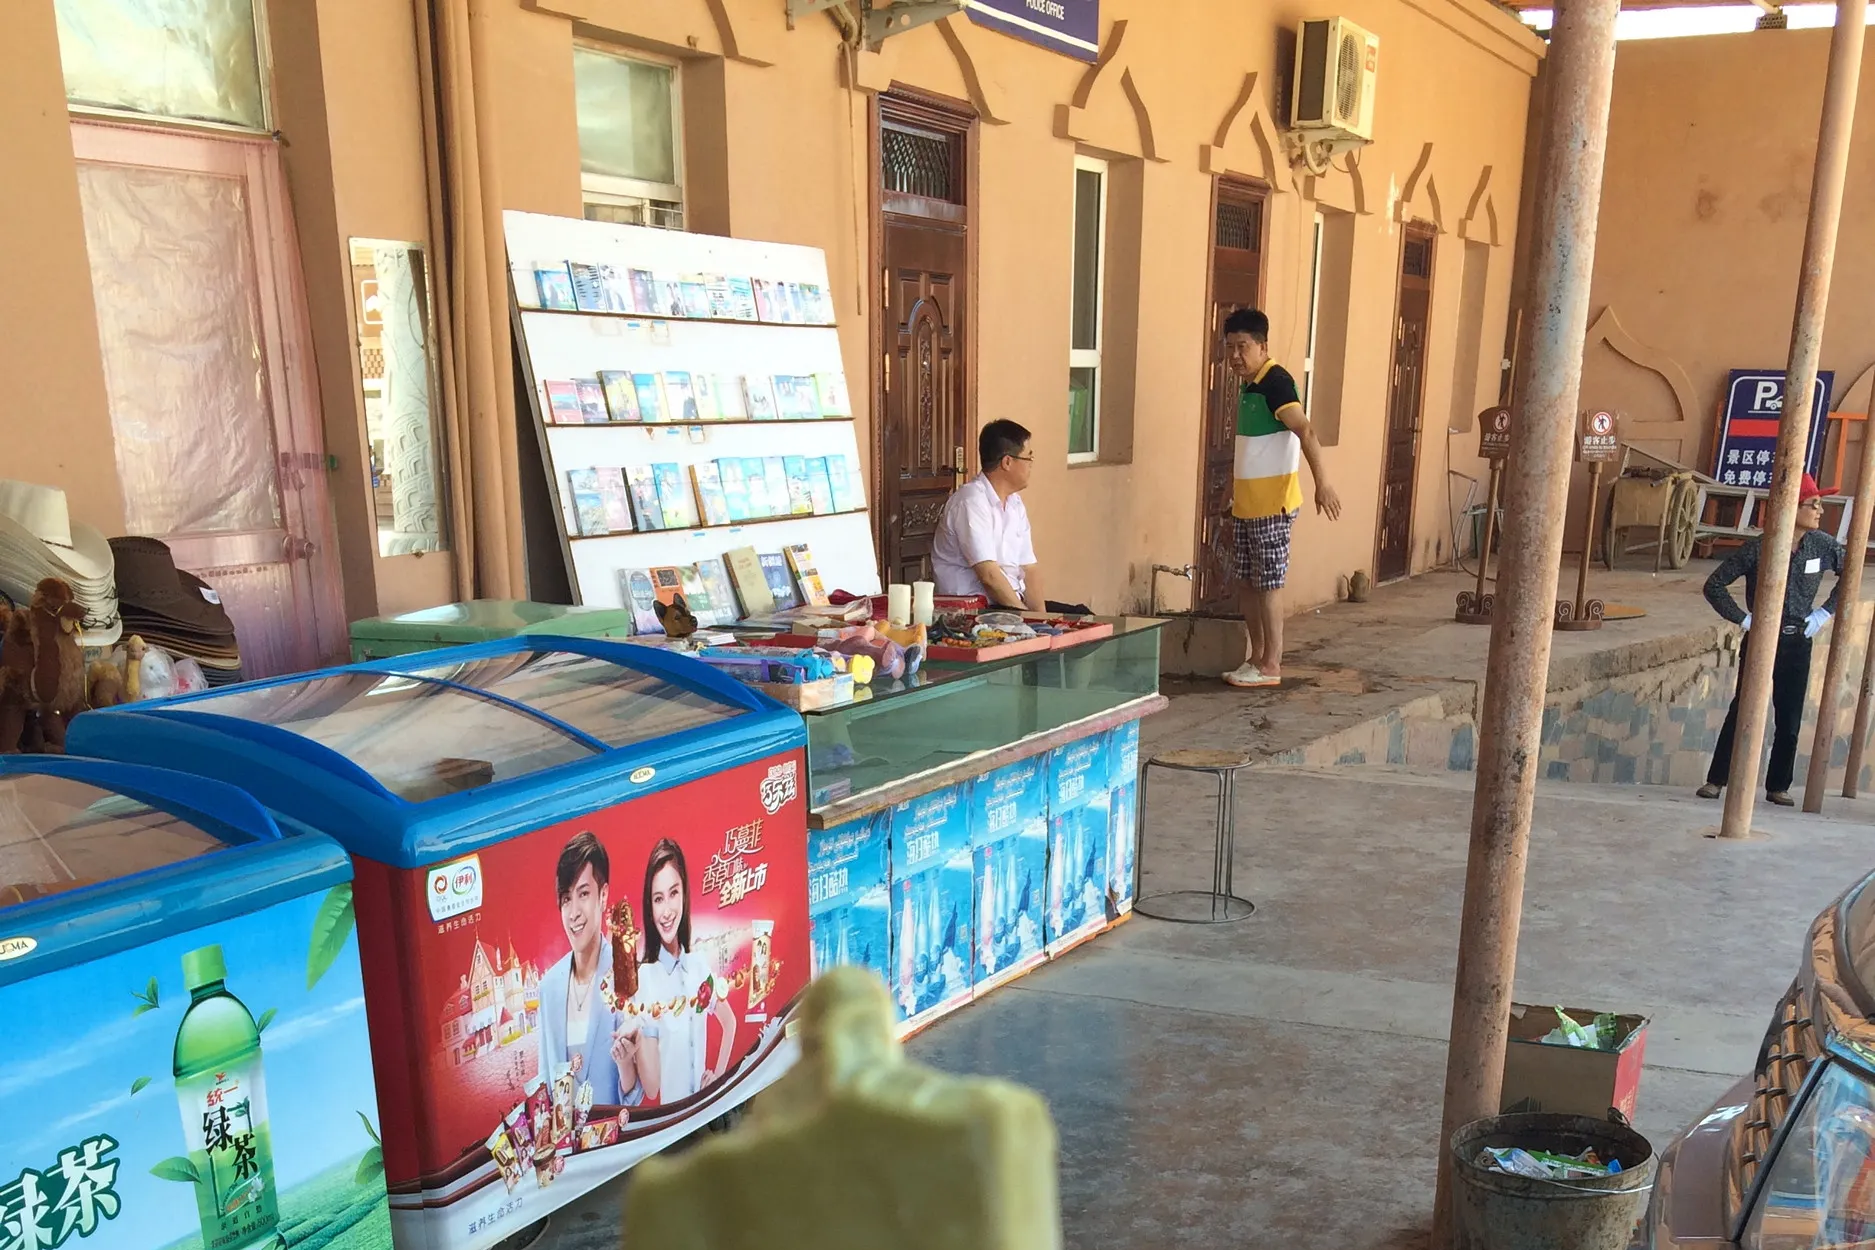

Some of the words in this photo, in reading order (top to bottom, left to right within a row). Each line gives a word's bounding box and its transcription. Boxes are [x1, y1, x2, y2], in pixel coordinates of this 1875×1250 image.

[1046, 0, 1065, 20] OFFICE
[1753, 381, 1778, 410] P
[1584, 435, 1616, 445] 游客止步
[1727, 449, 1776, 466] 景区停
[1723, 469, 1773, 486] 免费停
[724, 818, 764, 855] 巧蔓菲
[455, 871, 473, 889] 伊利
[718, 863, 768, 909] 全新上市
[206, 1086, 239, 1107] 统一
[203, 1105, 258, 1182] 绿茶
[468, 1197, 523, 1235] 滋养生命活力
